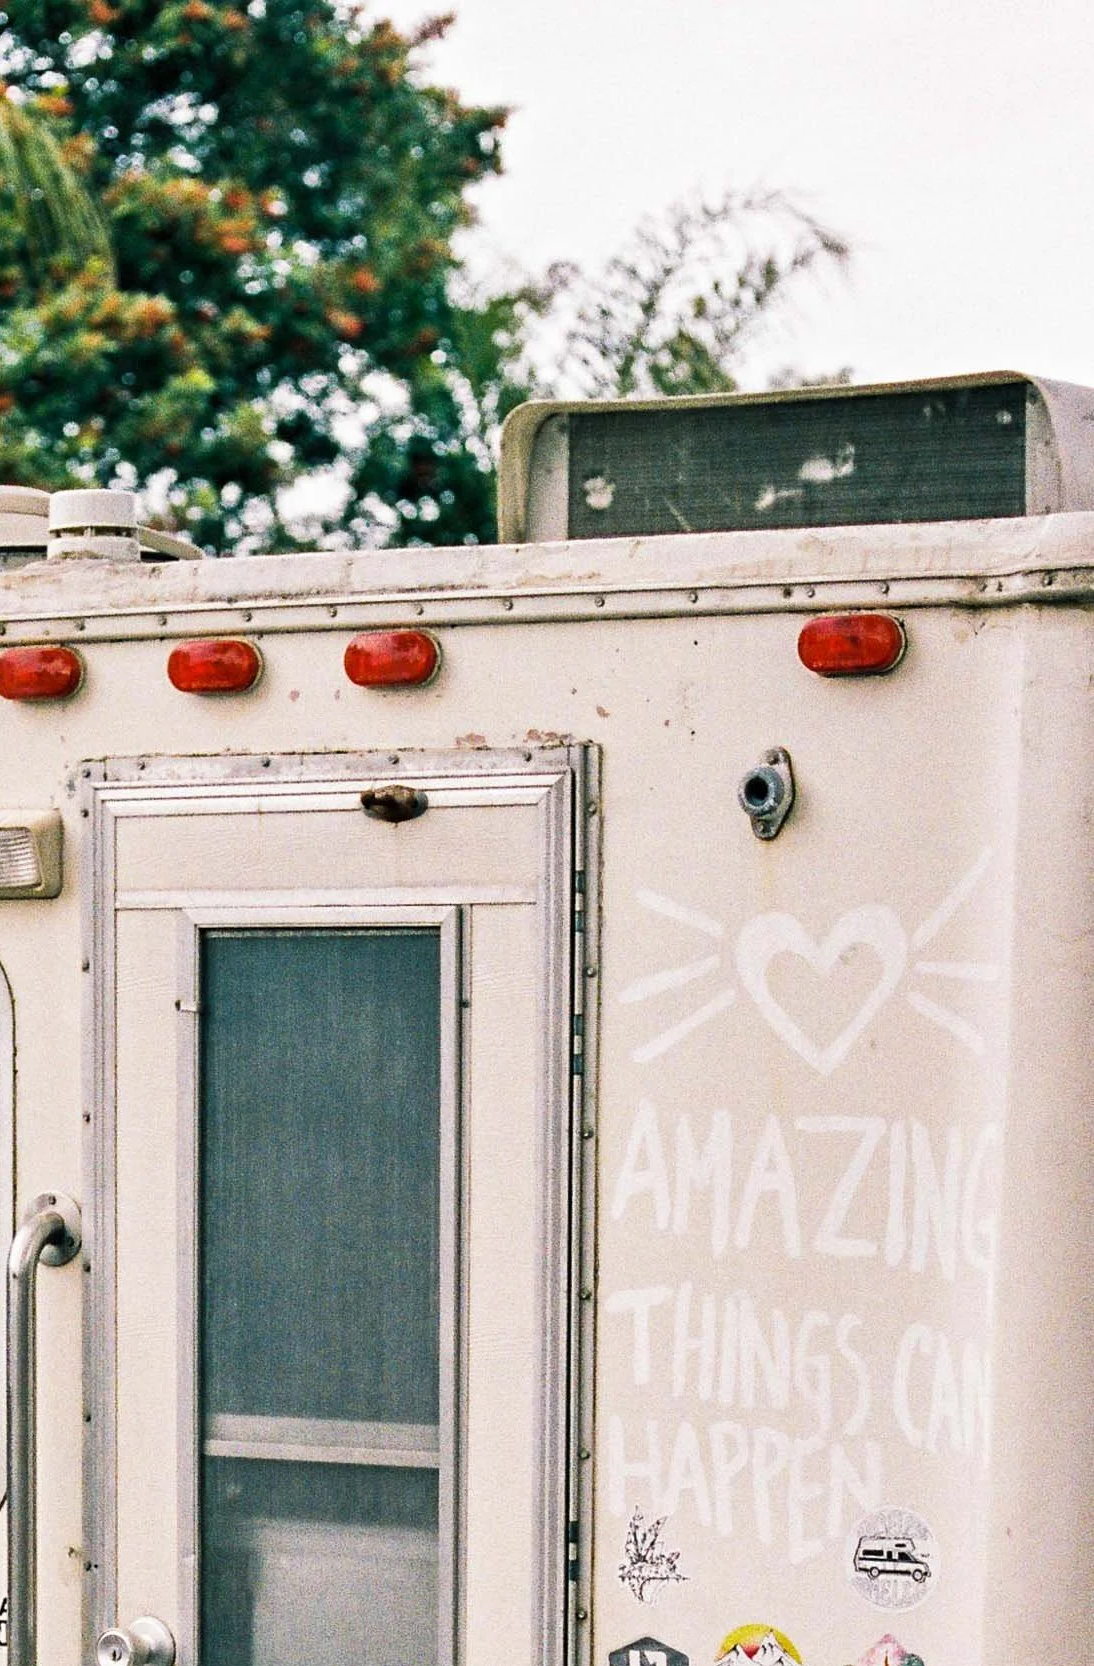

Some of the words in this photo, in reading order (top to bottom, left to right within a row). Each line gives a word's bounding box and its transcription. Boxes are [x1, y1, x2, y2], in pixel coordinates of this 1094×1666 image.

[610, 1099, 1005, 1281] AMAZING
[605, 1281, 870, 1435] THINGS
[893, 1323, 991, 1453] CAN
[609, 1414, 884, 1562] HAPPEN
